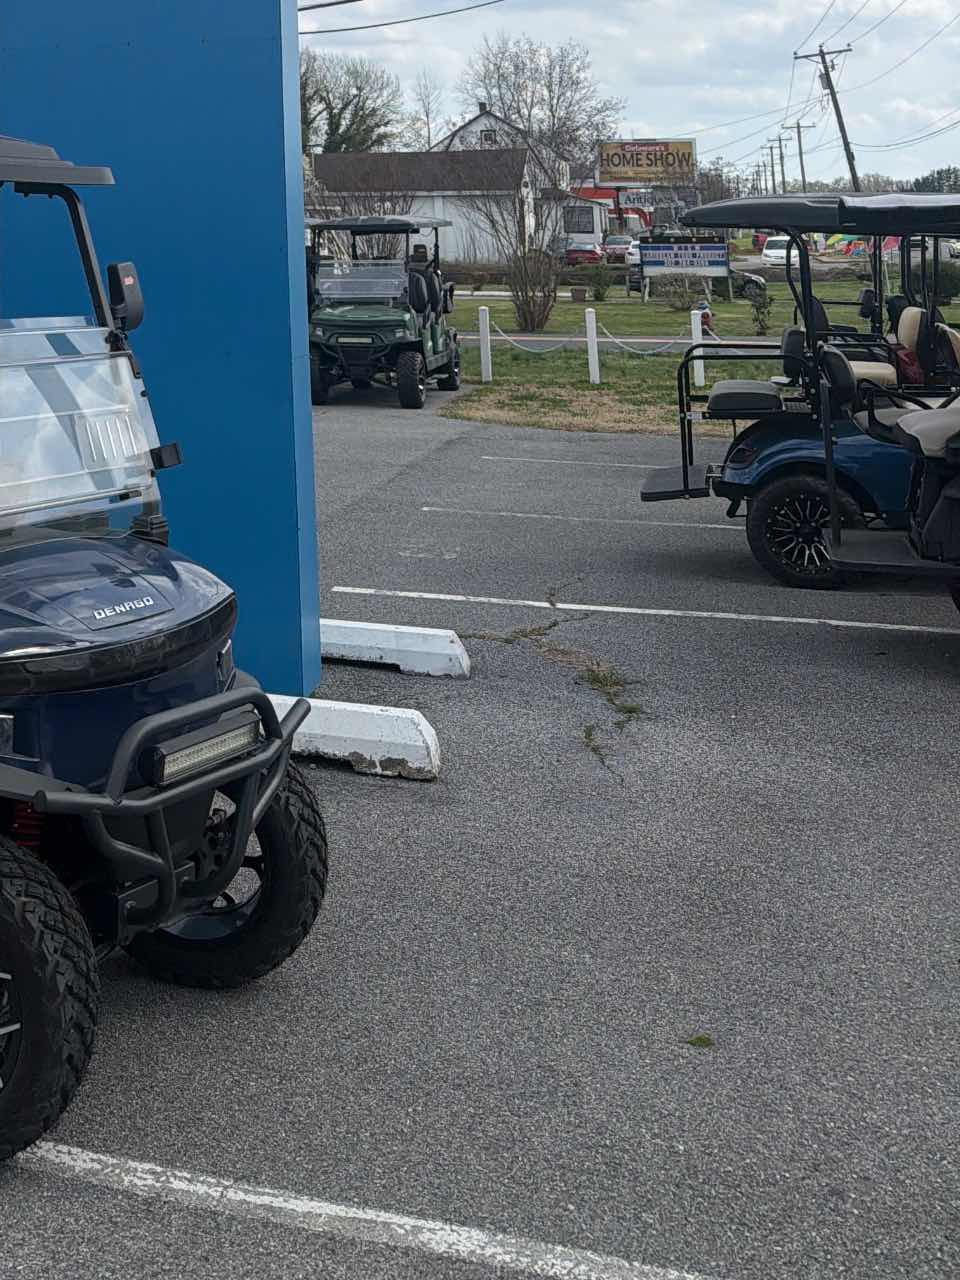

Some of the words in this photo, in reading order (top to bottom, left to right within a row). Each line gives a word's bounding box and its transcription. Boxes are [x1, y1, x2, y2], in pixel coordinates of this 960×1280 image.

[600, 152, 642, 168] HOME
[646, 152, 692, 168] SHOW
[93, 596, 154, 620] DENAGO
